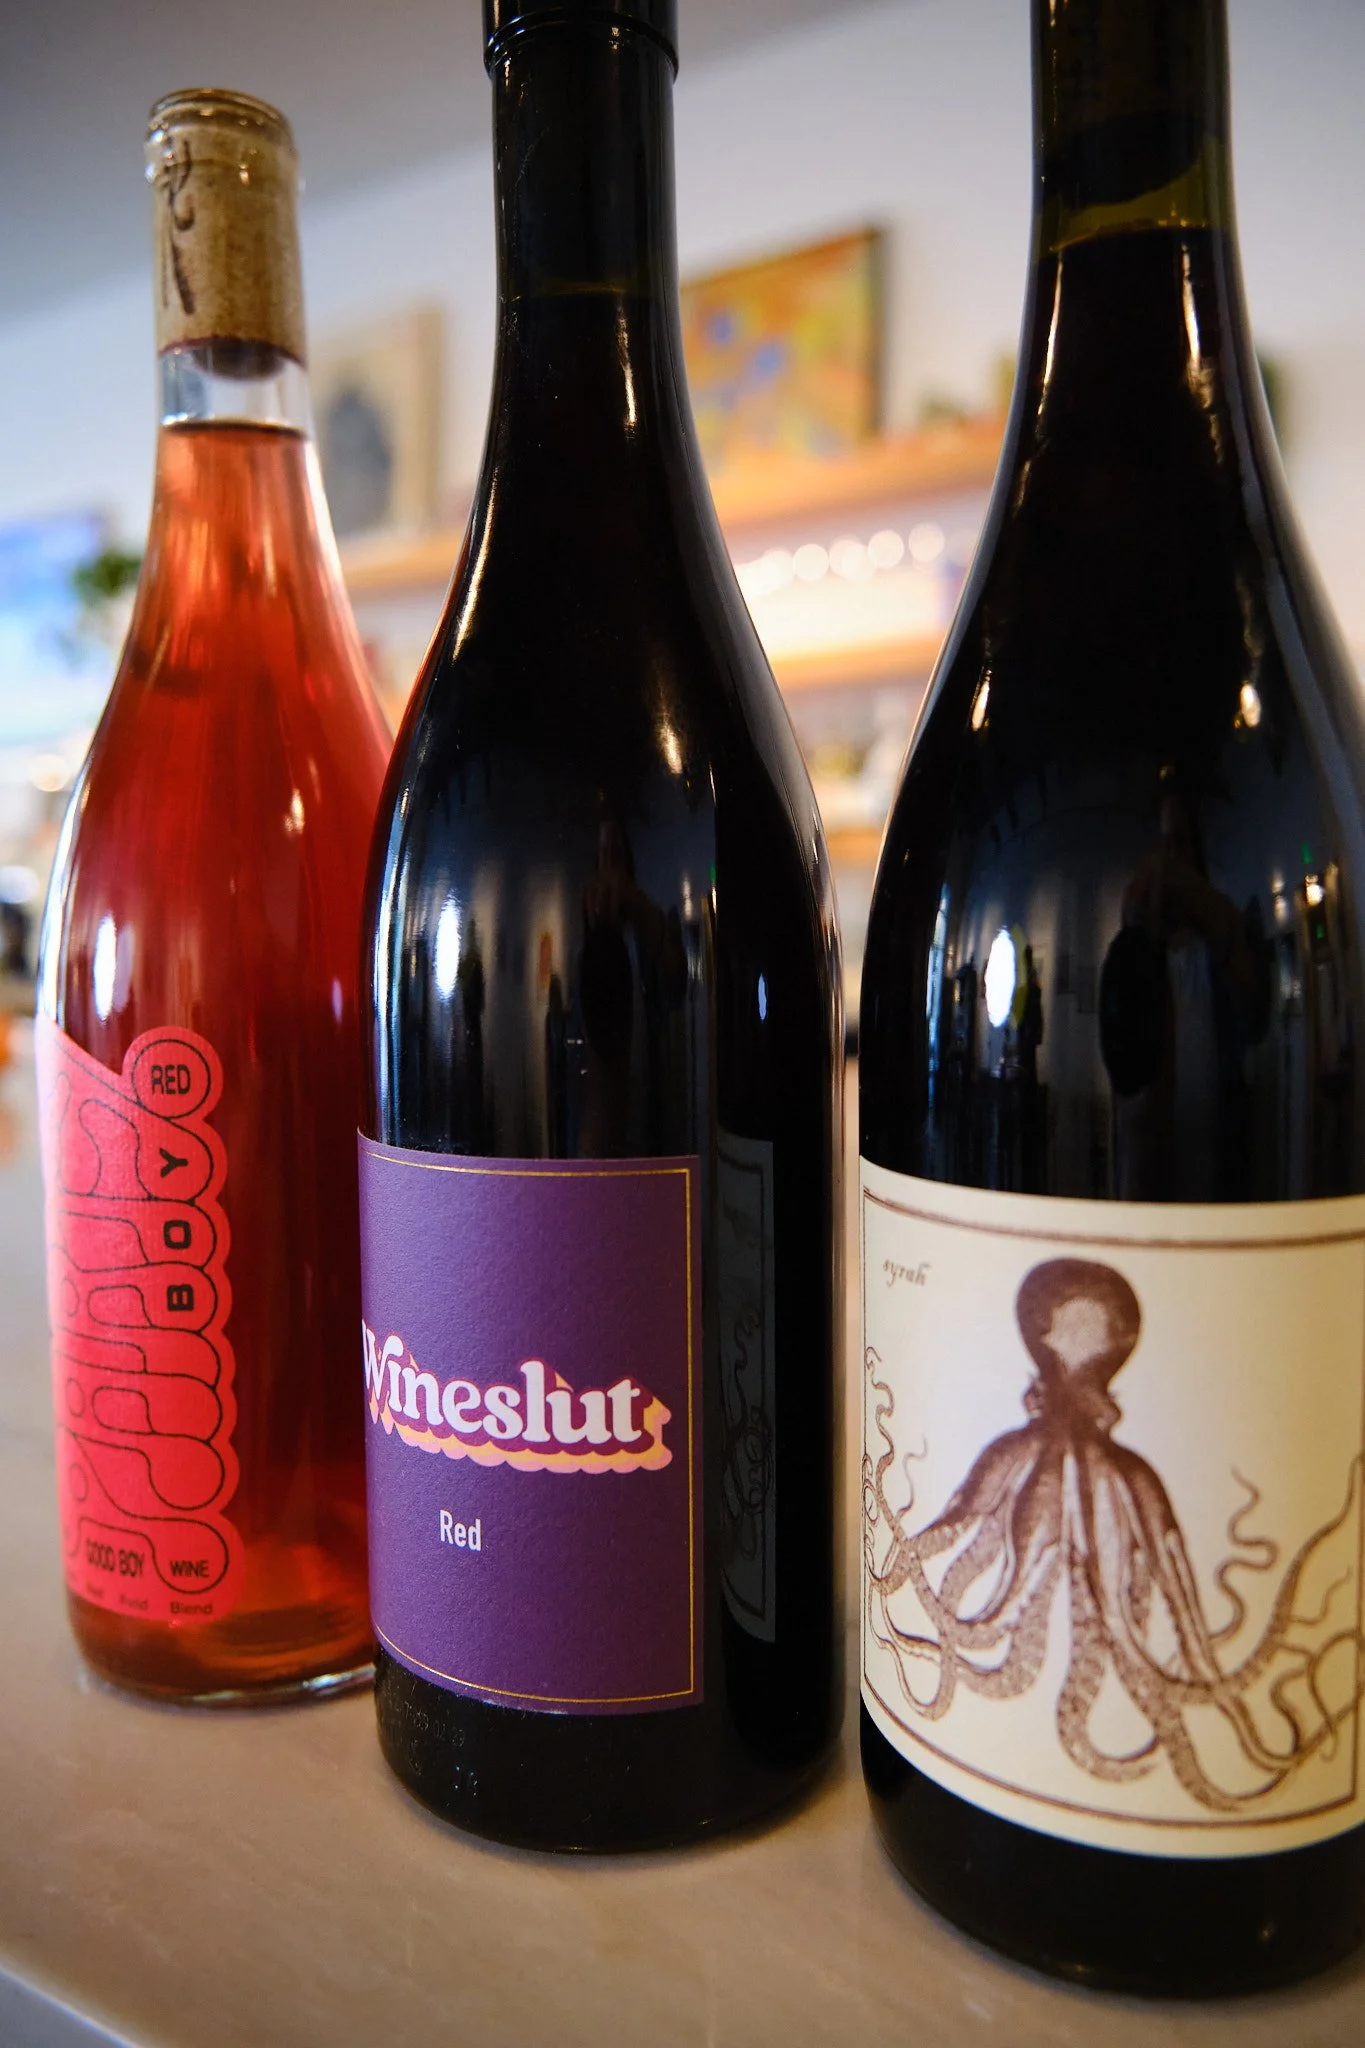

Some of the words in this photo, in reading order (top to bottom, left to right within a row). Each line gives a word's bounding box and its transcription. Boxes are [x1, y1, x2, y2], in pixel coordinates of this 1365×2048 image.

[151, 1064, 191, 1095] RED
[883, 1259, 932, 1288] syrah
[361, 1318, 643, 1445] Wineslut
[440, 1509, 481, 1551] Red
[119, 1547, 145, 1578] BOY
[170, 1560, 209, 1578] WINE
[169, 1601, 213, 1616] Blend
